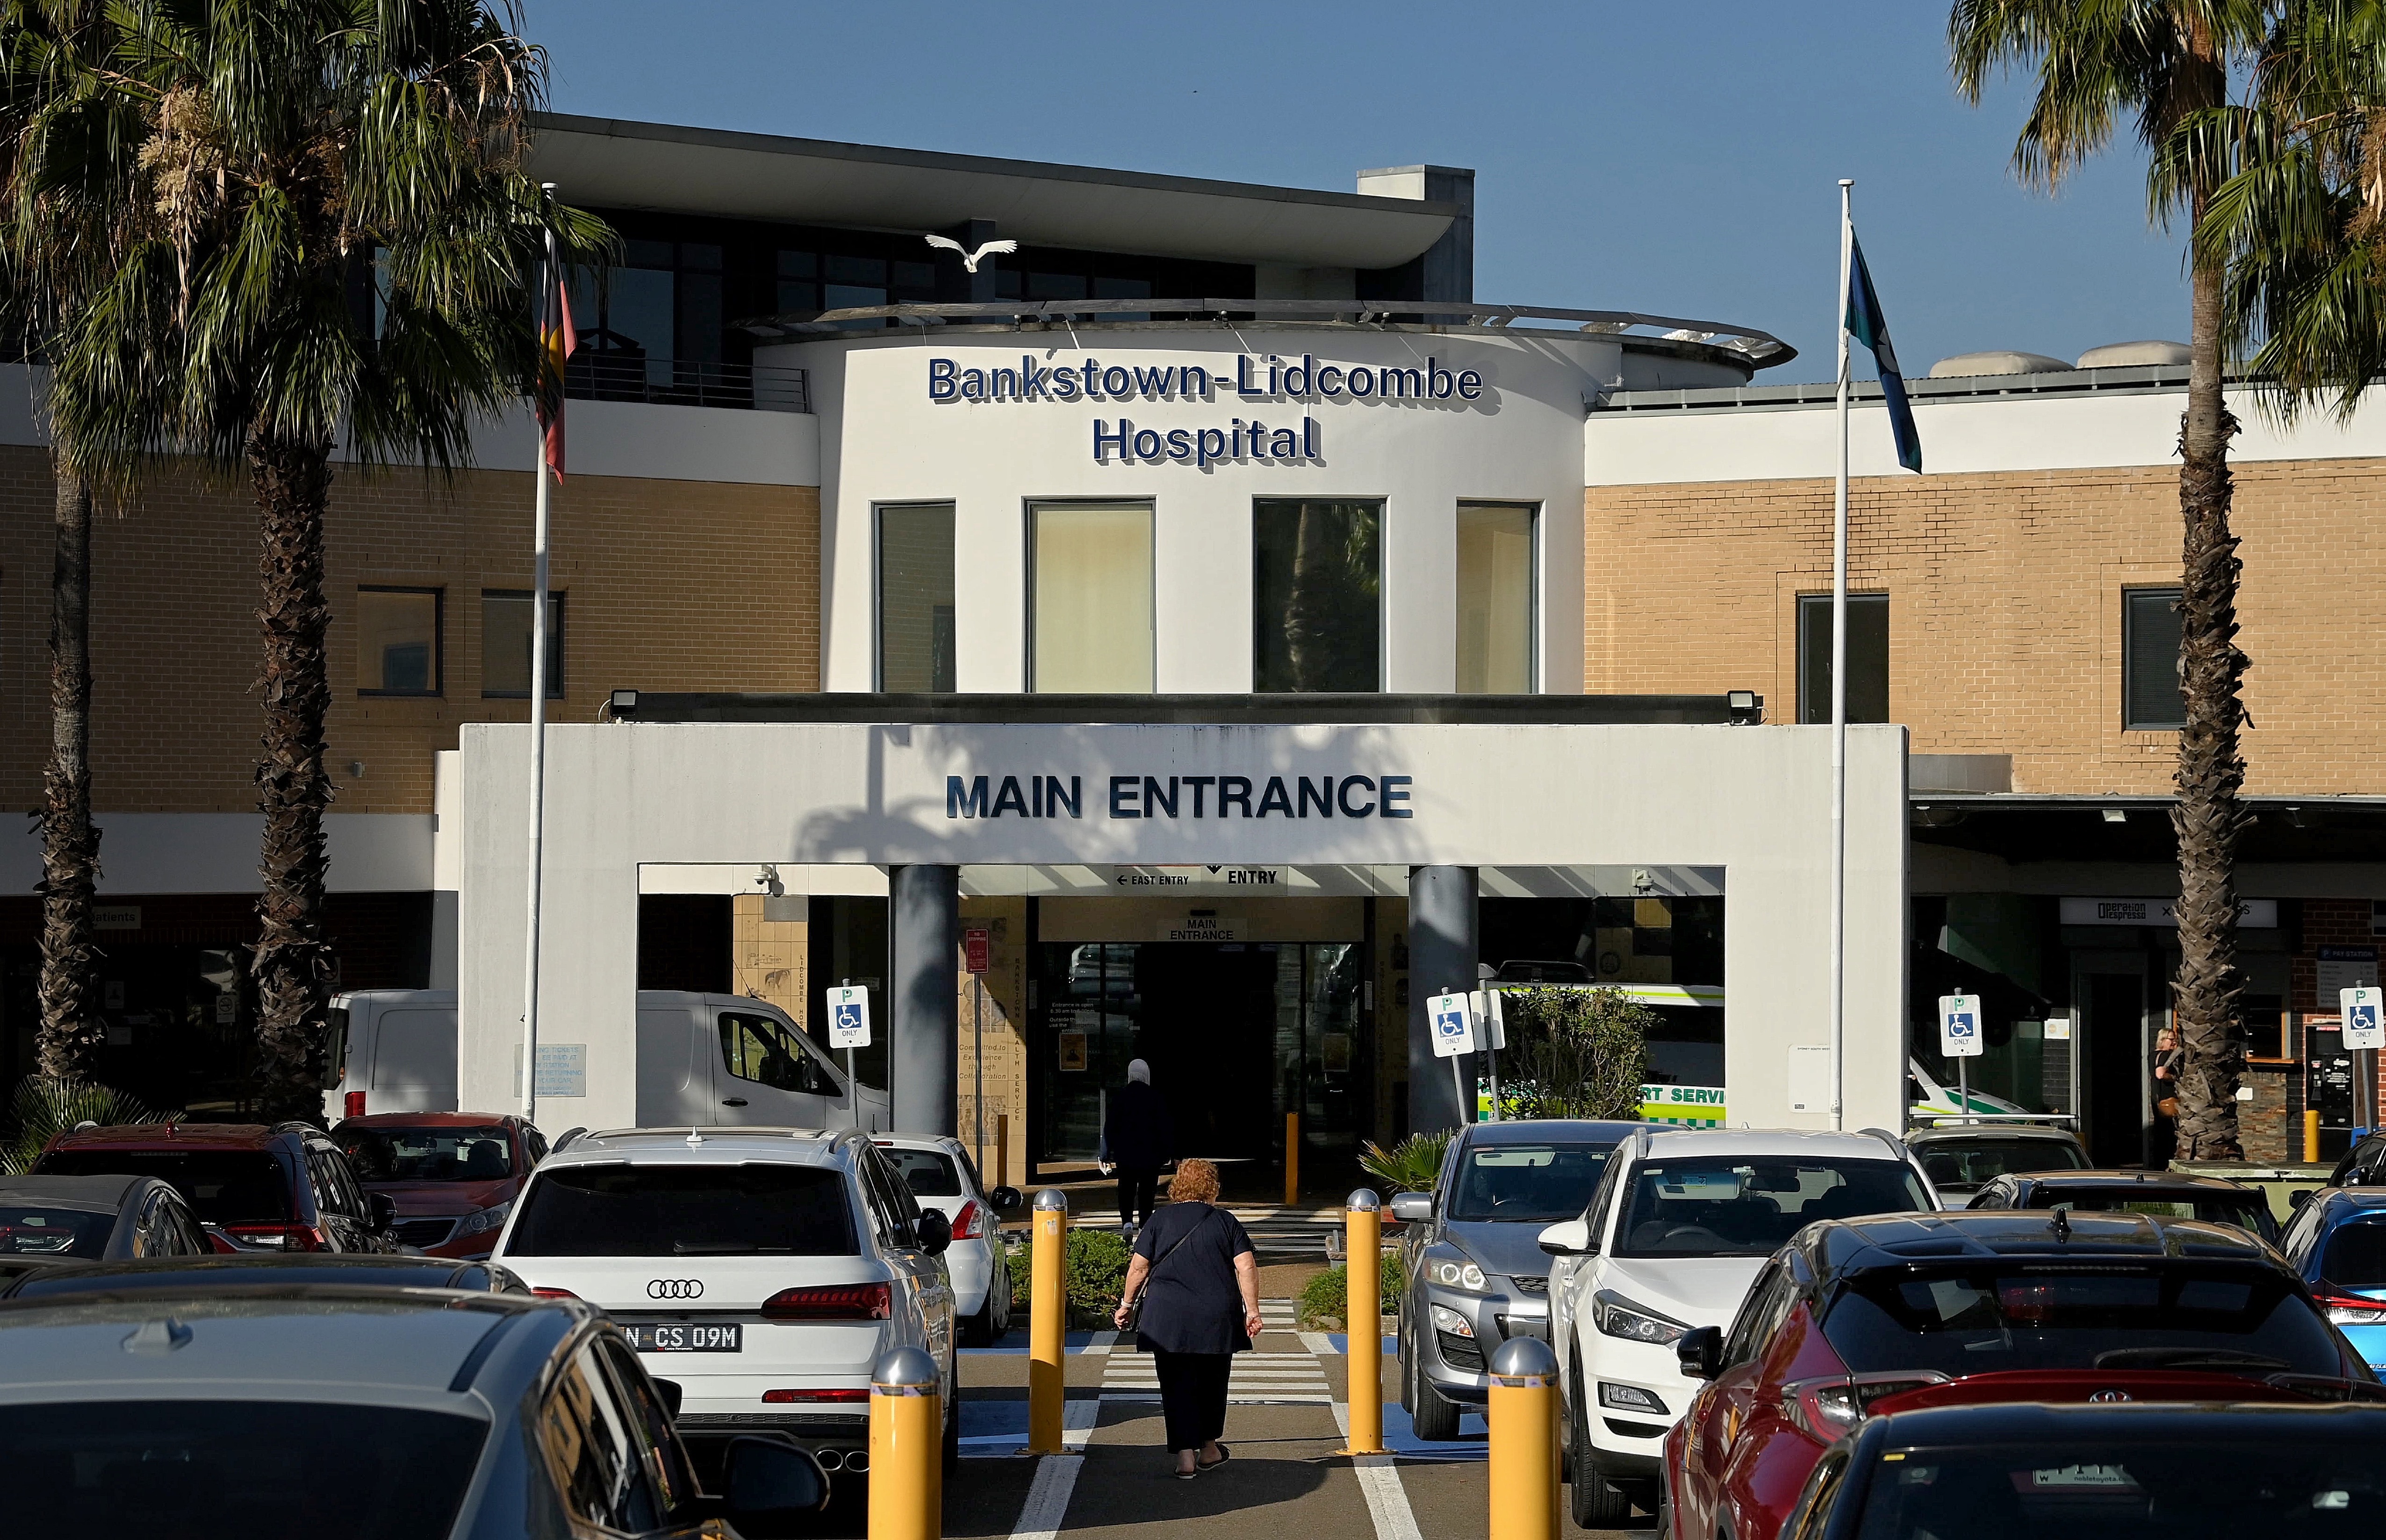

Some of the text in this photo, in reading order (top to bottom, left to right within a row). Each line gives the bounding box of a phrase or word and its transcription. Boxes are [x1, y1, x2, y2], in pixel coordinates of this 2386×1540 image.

[928, 354, 1484, 401] Bankstown-Lidcombe
[1093, 417, 1316, 467] Hospital
[946, 775, 1413, 819] MAIN ENTRANCE
[1132, 876, 1189, 885] EAST ENTRY
[1228, 871, 1277, 884] ENTRY
[1187, 919, 1216, 928] MAIN
[1170, 930, 1234, 940] ENTRANCE
[842, 989, 853, 1003] P
[2356, 990, 2366, 1004] P
[1442, 997, 1452, 1011] P
[1954, 998, 1965, 1011] P
[1671, 1088, 1725, 1104] SERVI
[655, 1327, 684, 1347] CS
